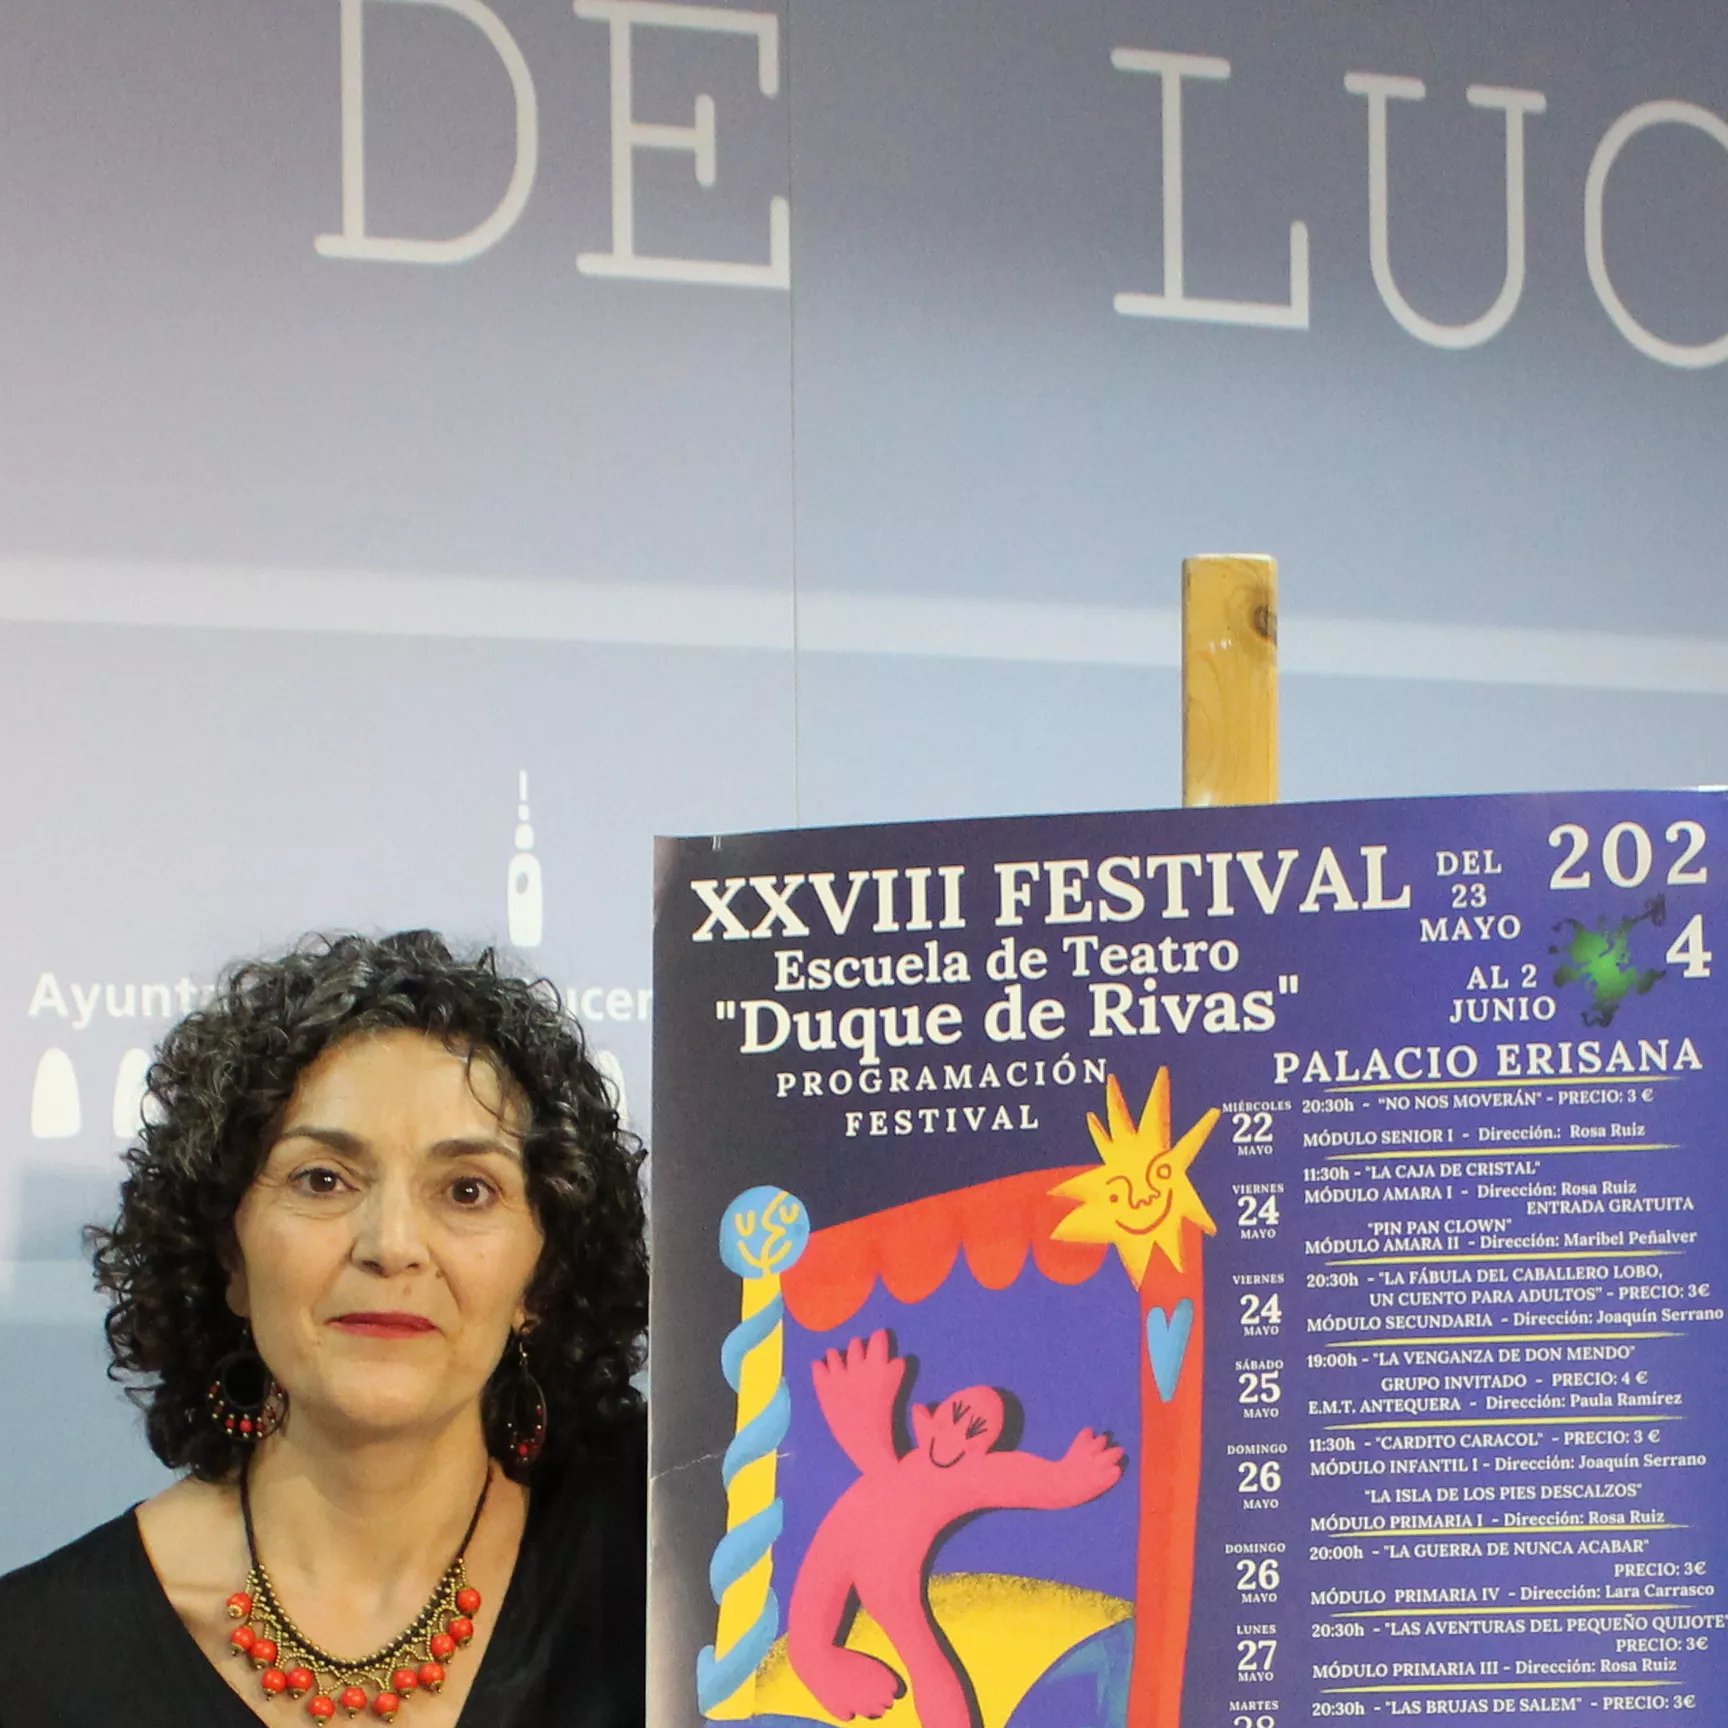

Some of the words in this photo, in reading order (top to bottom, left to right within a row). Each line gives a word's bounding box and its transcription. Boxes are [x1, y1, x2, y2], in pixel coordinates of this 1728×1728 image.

[313, 0, 790, 289] DE
[1435, 849, 1501, 875] DEL
[690, 865, 965, 942] XXVIII
[993, 845, 1410, 926] FESTIVAL
[1451, 882, 1486, 908] 23
[1419, 914, 1520, 941] MAYO
[1666, 913, 1712, 977] 4
[774, 940, 971, 991] Escuela
[986, 938, 1048, 983] de
[1062, 936, 1239, 976] Teatro
[1466, 965, 1508, 989] AL
[1521, 963, 1536, 987] 2
[715, 998, 962, 1062] "Duque
[983, 984, 1066, 1042] de
[1088, 974, 1299, 1037] Rivas"
[1449, 995, 1555, 1023] JUNIO
[1273, 1044, 1478, 1086] PALACIO
[1498, 1037, 1703, 1080] ERISANA
[776, 1053, 1109, 1097] PROGRAMACIÓN
[1222, 1099, 1291, 1114] MIÉRCOLES
[845, 1104, 1038, 1136] FESTIVAL
[1232, 1111, 1273, 1143] 22
[1237, 1144, 1273, 1155] MAYO
[1232, 1183, 1284, 1194] VIERNES
[1237, 1194, 1279, 1225] 24
[1526, 1199, 1604, 1214] ENTRADA
[1608, 1196, 1693, 1212] GRATUITA
[1240, 1228, 1276, 1239] MAYO
[1367, 1221, 1401, 1235] "PIN
[1406, 1220, 1439, 1234] PAN
[1443, 1217, 1511, 1233] CLOWN"
[1232, 1273, 1284, 1284] VIERNES
[1240, 1293, 1282, 1324] 24
[1243, 1325, 1279, 1336] MAYO
[1235, 1358, 1283, 1372] SÁBADO
[1238, 1370, 1280, 1403] 25
[1243, 1407, 1279, 1418] MAYO
[1227, 1443, 1287, 1454] DOMINGO
[1238, 1460, 1281, 1492] 26
[1243, 1498, 1278, 1509] MAYO
[1364, 1489, 1391, 1503] "LA
[1395, 1488, 1432, 1502] ISLA
[1436, 1487, 1458, 1501] DE
[1463, 1486, 1495, 1500] LOS
[1499, 1485, 1535, 1500] PIES
[1540, 1483, 1641, 1499] DESCALZOS"
[1225, 1542, 1285, 1553] DOMINGO
[1236, 1558, 1280, 1590] 26
[1241, 1592, 1277, 1603] MAYO
[1236, 1624, 1276, 1634] LUNES
[1236, 1639, 1276, 1670] 27
[1238, 1668, 1274, 1681] MAYO
[1229, 1700, 1278, 1710] MARTES
